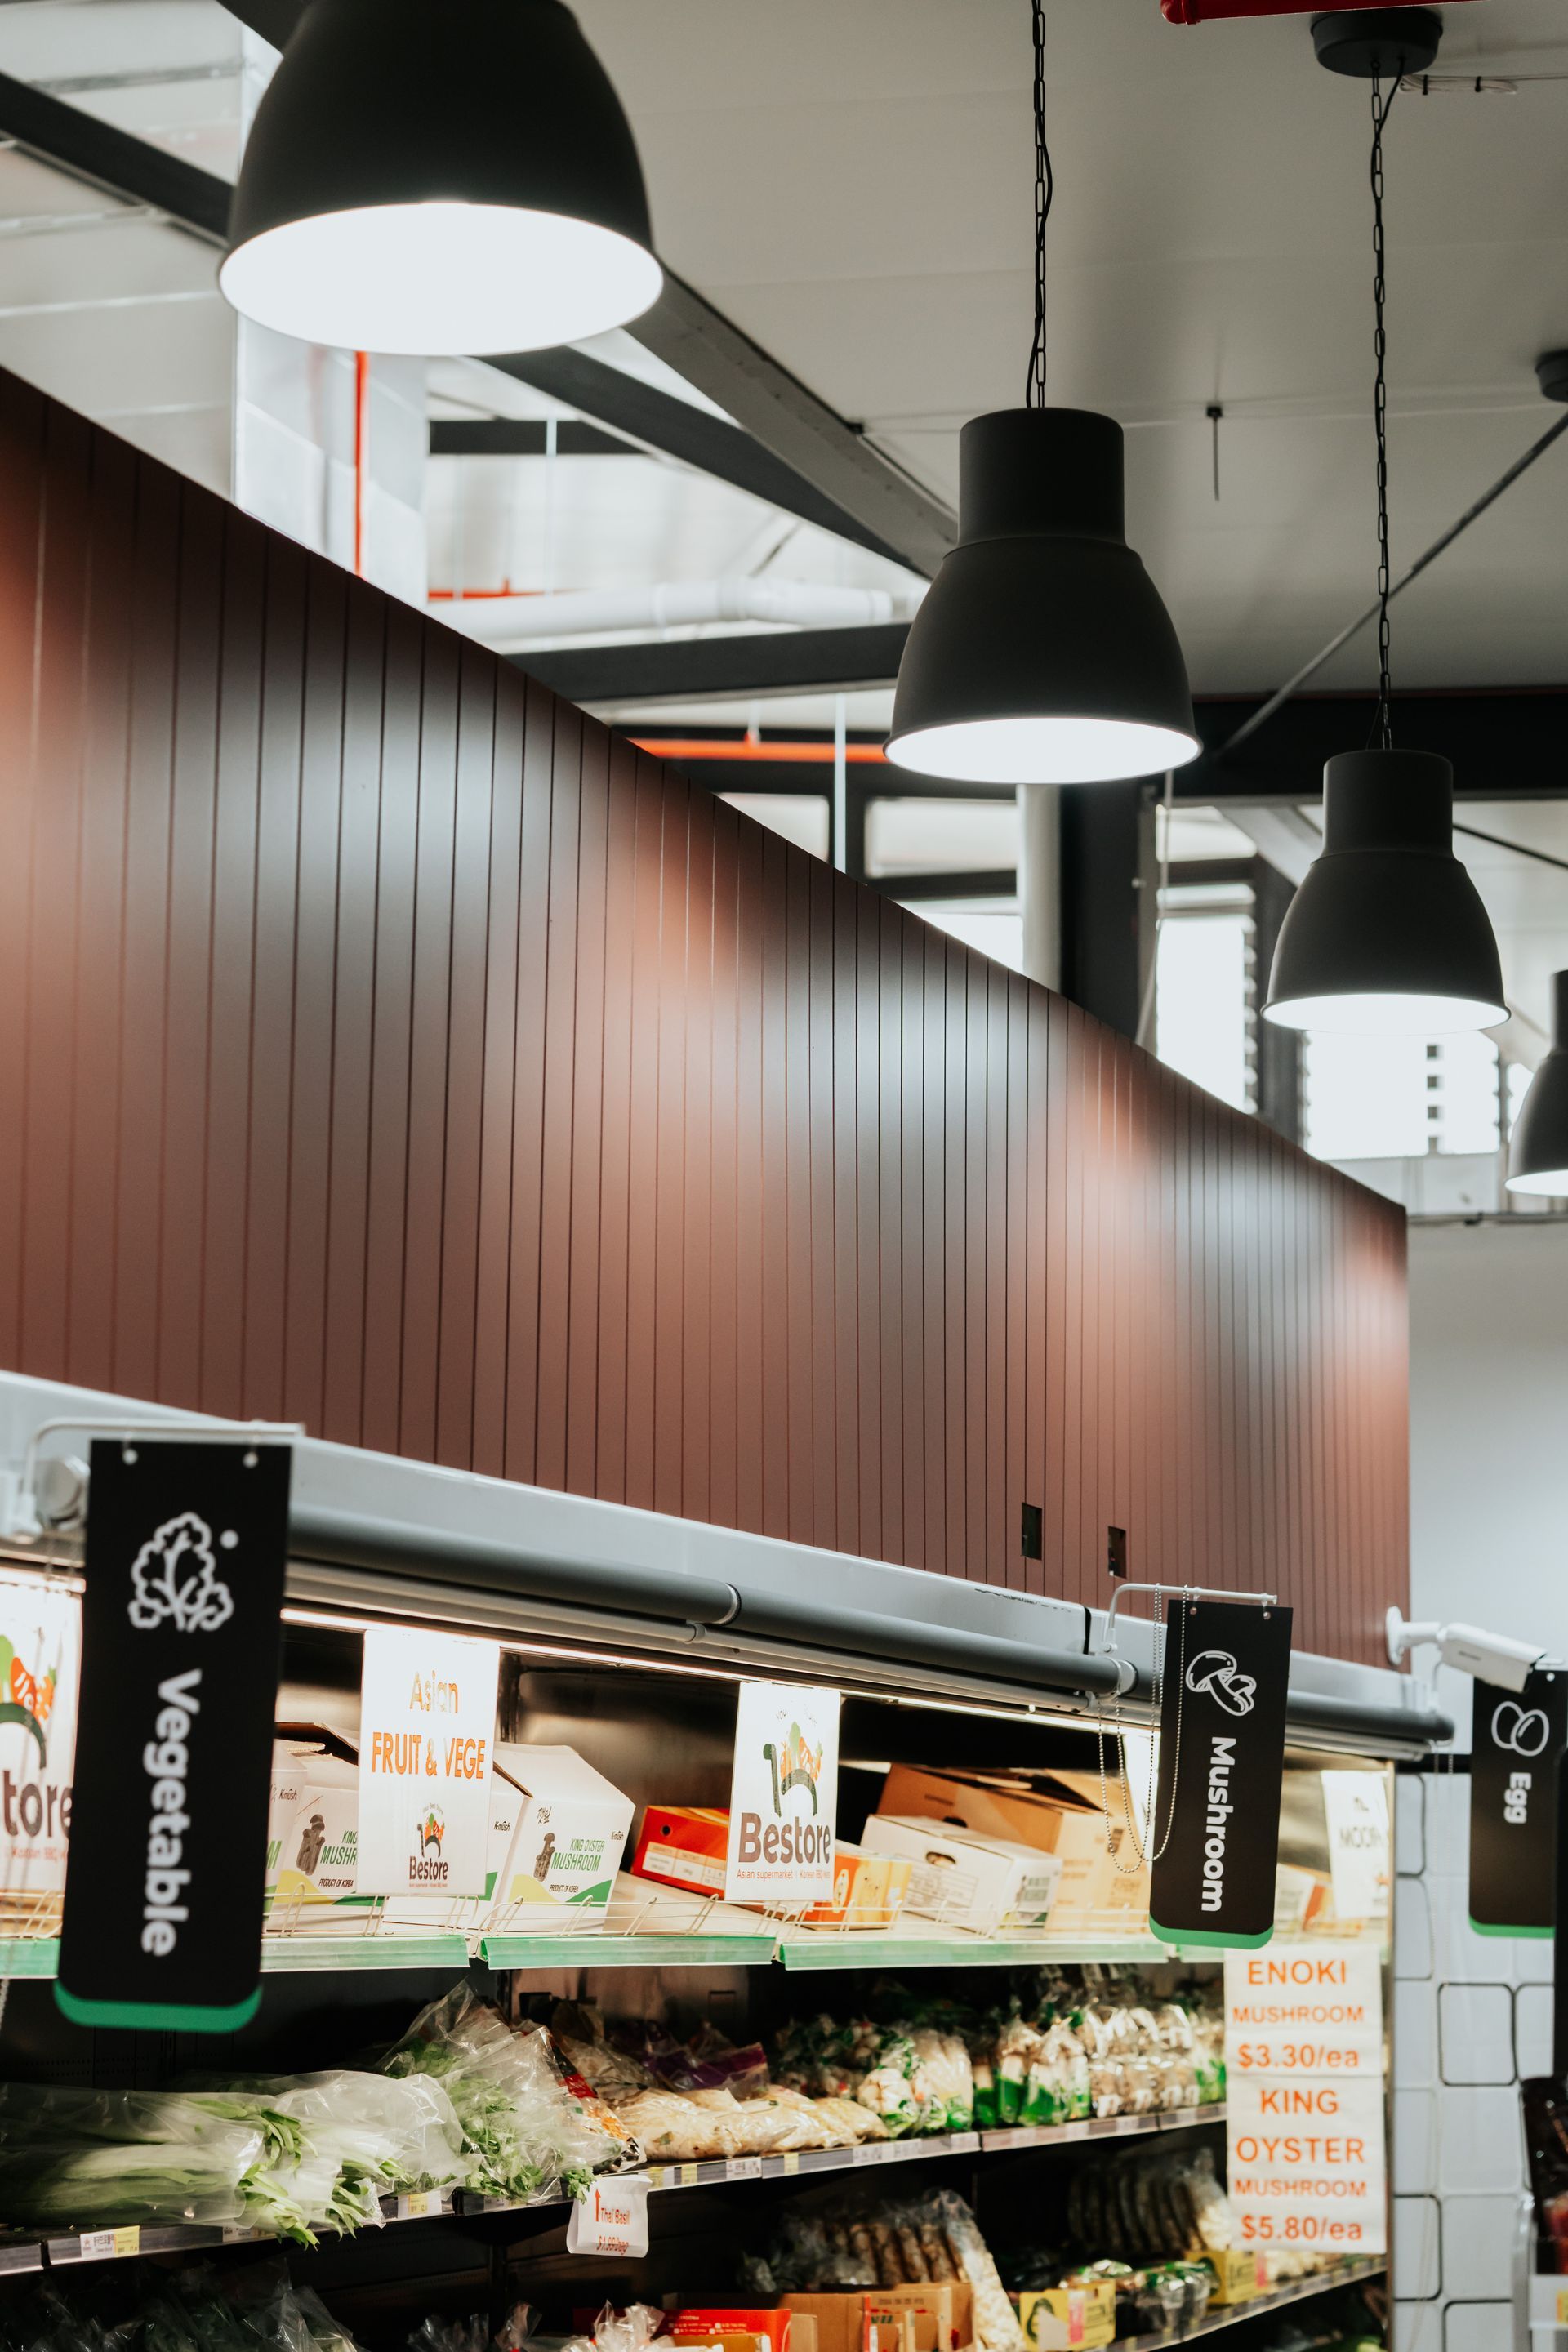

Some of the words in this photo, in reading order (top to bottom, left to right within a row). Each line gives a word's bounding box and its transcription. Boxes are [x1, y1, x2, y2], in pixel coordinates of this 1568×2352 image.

[409, 1670, 458, 1713] Asian
[372, 1731, 422, 1775] FRUIT
[425, 1738, 438, 1776] &
[443, 1737, 486, 1780] VEGE
[1504, 1772, 1532, 1824] Egg
[141, 1668, 202, 1956] Vegetable
[1200, 1737, 1236, 1912] Mushroom
[342, 1830, 358, 1844] KING
[570, 1838, 584, 1851] KING
[584, 1840, 605, 1852] OYSTER
[738, 1812, 831, 1864] Bestore
[409, 1855, 448, 1880] Bestore
[551, 1852, 602, 1872] MUSHROOM
[318, 1878, 336, 1887] PRODUCT
[336, 1879, 342, 1888] OF
[341, 1879, 354, 1888] KOREA
[737, 1869, 755, 1879] Asian
[757, 1869, 793, 1881] supermarket
[1247, 1960, 1347, 1985] ENOKI
[1233, 2006, 1364, 2025] MUSHROOM
[1238, 2044, 1359, 2069] $3.30/ea
[1260, 2089, 1339, 2115] KING
[1236, 2137, 1365, 2164] OYSTER
[1235, 2179, 1367, 2198] MUSHROOM
[600, 2207, 614, 2223] Thai
[1241, 2215, 1362, 2241] $5.80/ea
